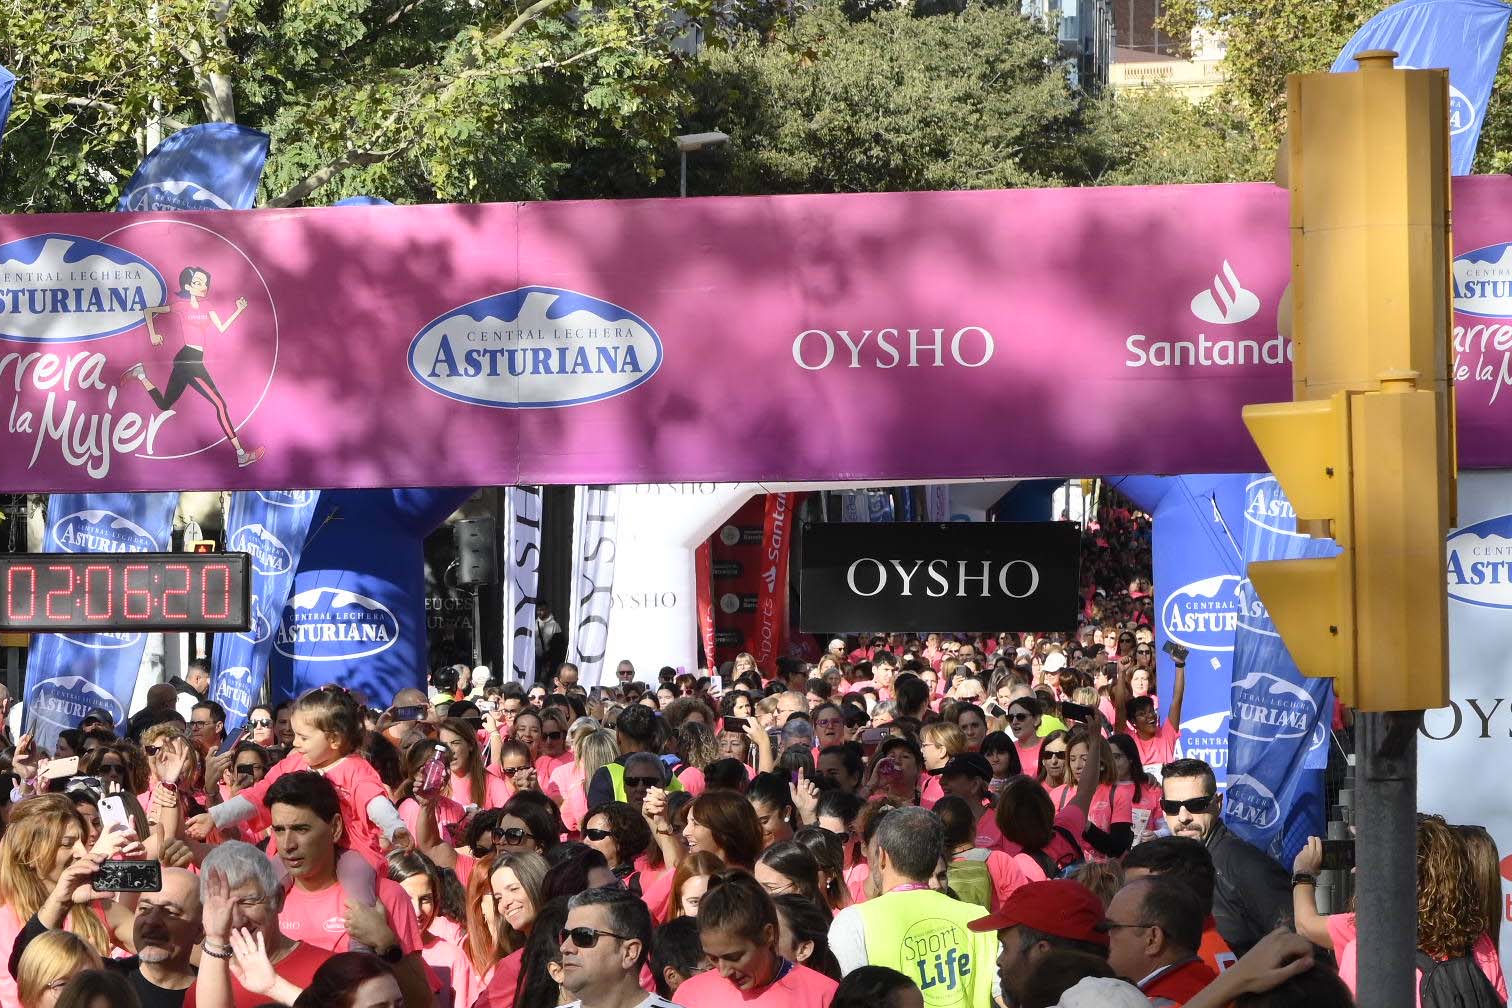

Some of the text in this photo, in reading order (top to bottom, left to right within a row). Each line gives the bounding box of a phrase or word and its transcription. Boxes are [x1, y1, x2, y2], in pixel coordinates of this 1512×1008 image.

[70, 269, 144, 281] LECHERA
[466, 327, 635, 342] CENTRAL LECHERA
[791, 325, 996, 373] OYSHO
[428, 333, 643, 378] ASTURIANA
[1475, 353, 1494, 382] la
[7, 394, 34, 436] la
[27, 386, 178, 479] Mujer
[7, 564, 230, 620] 02:06:20
[846, 557, 1040, 599] OYSHO
[1186, 600, 1236, 610] CENTRAL
[276, 616, 390, 645] ASTURIANA
[904, 925, 960, 961] Sport
[916, 947, 971, 991] Life
